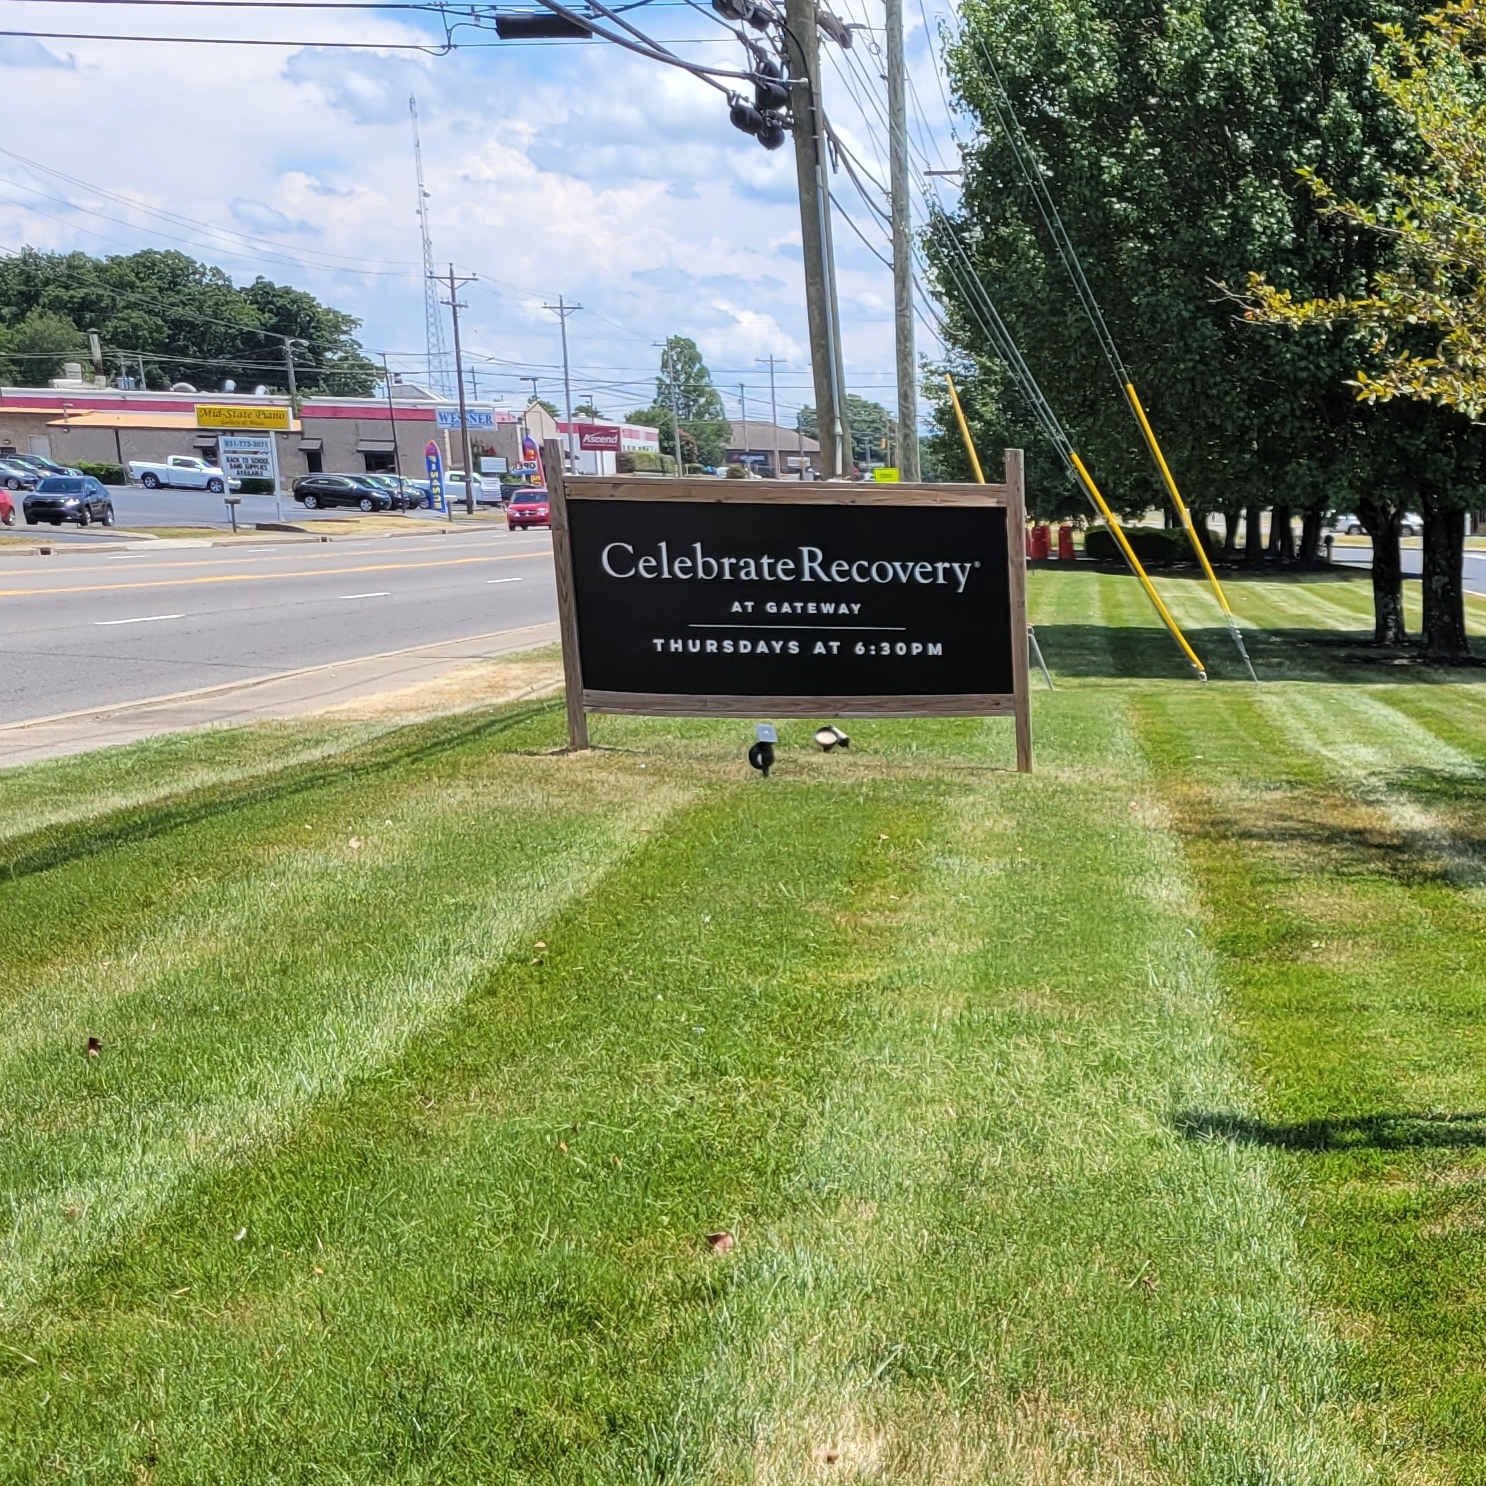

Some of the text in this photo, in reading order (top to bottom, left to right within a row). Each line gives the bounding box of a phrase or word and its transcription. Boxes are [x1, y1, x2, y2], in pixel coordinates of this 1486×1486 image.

[200, 408, 285, 420] Mid-State Piano
[582, 433, 618, 444] Ascend
[731, 601, 862, 615] AT GATEWAY
[652, 638, 944, 657] THURSDAYS AT 6:30PM
